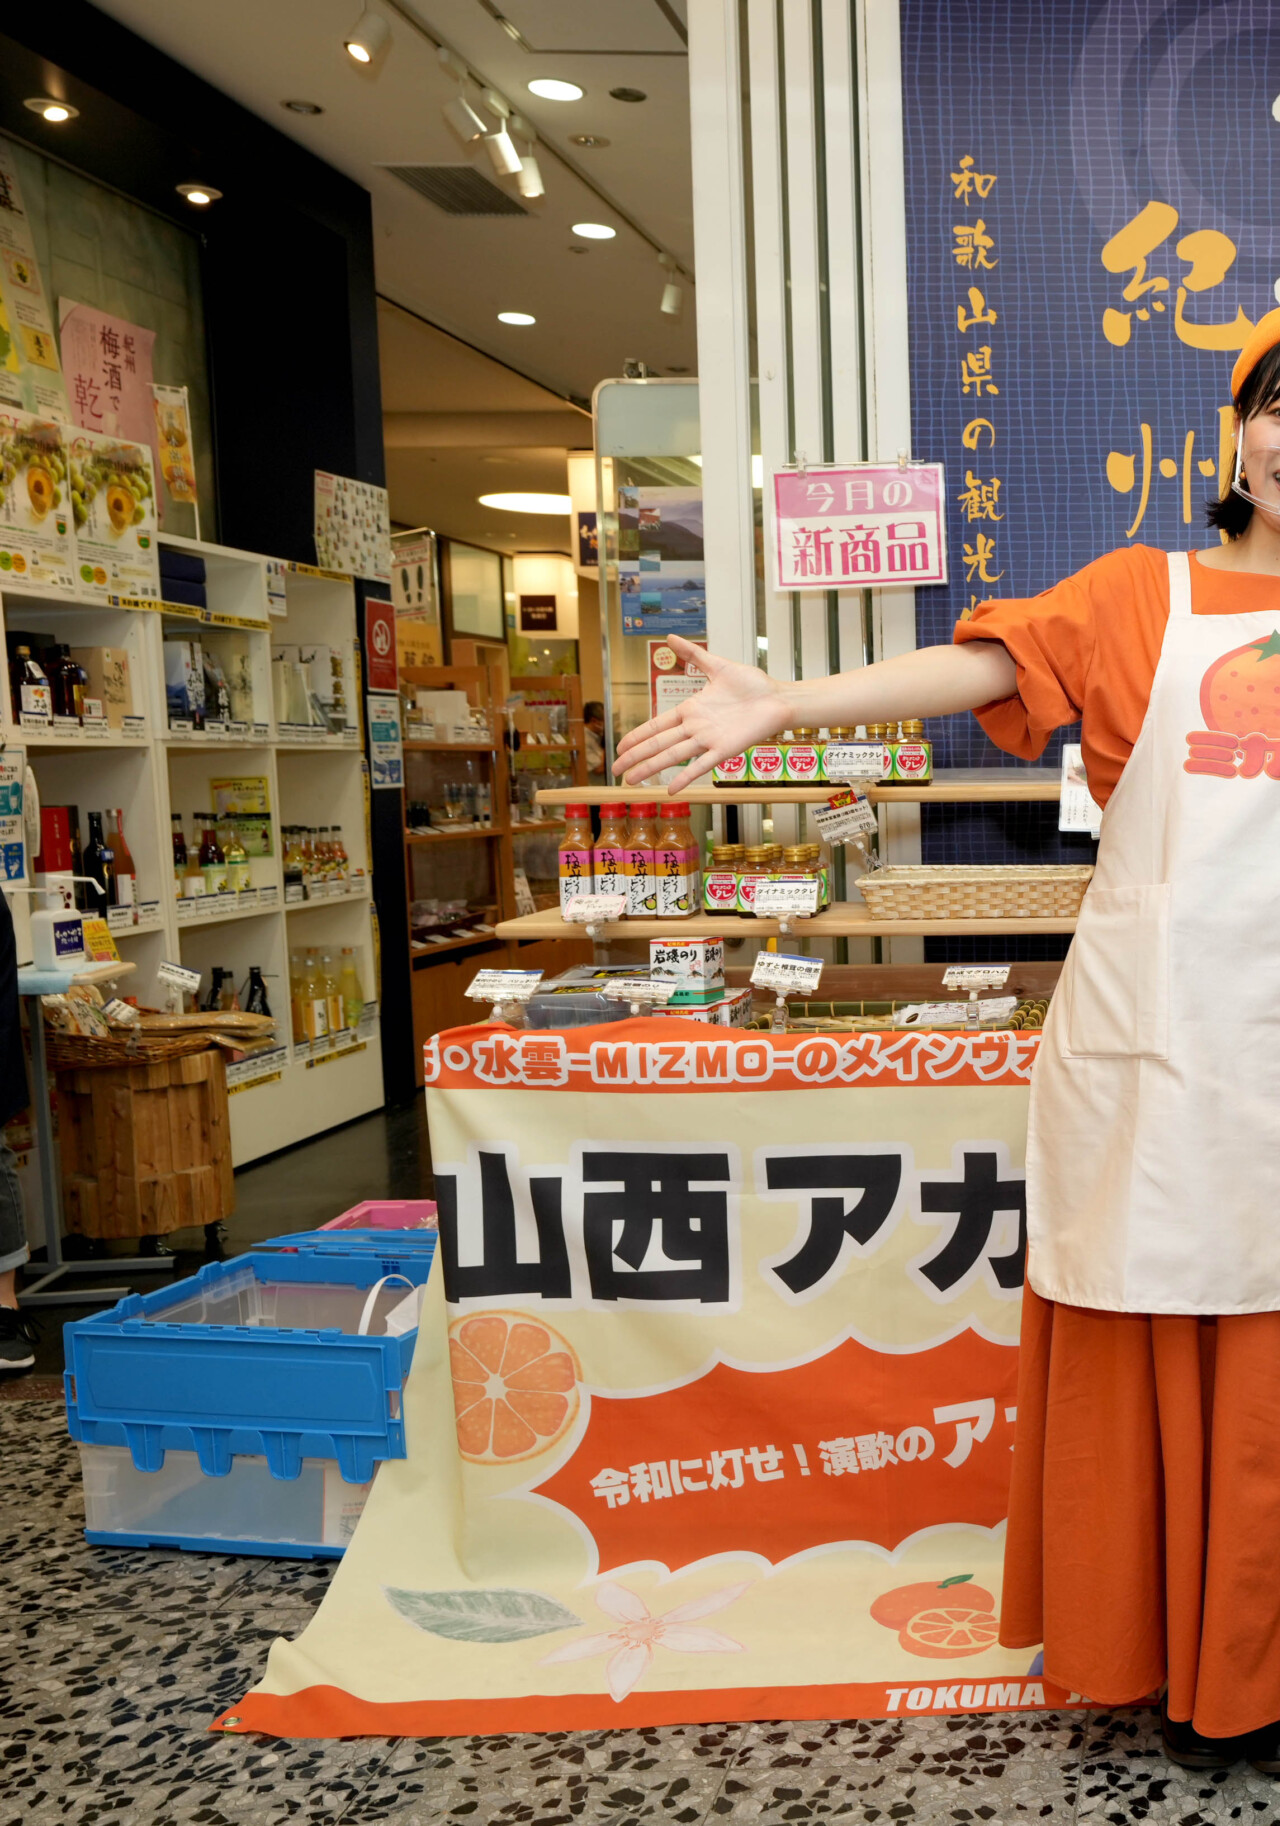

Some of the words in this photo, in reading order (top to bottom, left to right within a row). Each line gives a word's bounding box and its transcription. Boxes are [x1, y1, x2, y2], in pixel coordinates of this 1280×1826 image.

[805, 480, 914, 513] 今月の
[792, 522, 930, 577] 新商品
[828, 751, 883, 760] ダイナミックタレ
[653, 948, 697, 964] 岩磯のり
[433, 1150, 1026, 1303] 山西アカ
[589, 1397, 1018, 1509] 令和に灯せ！演歌のア
[886, 1683, 1046, 1711] TOKUMA
